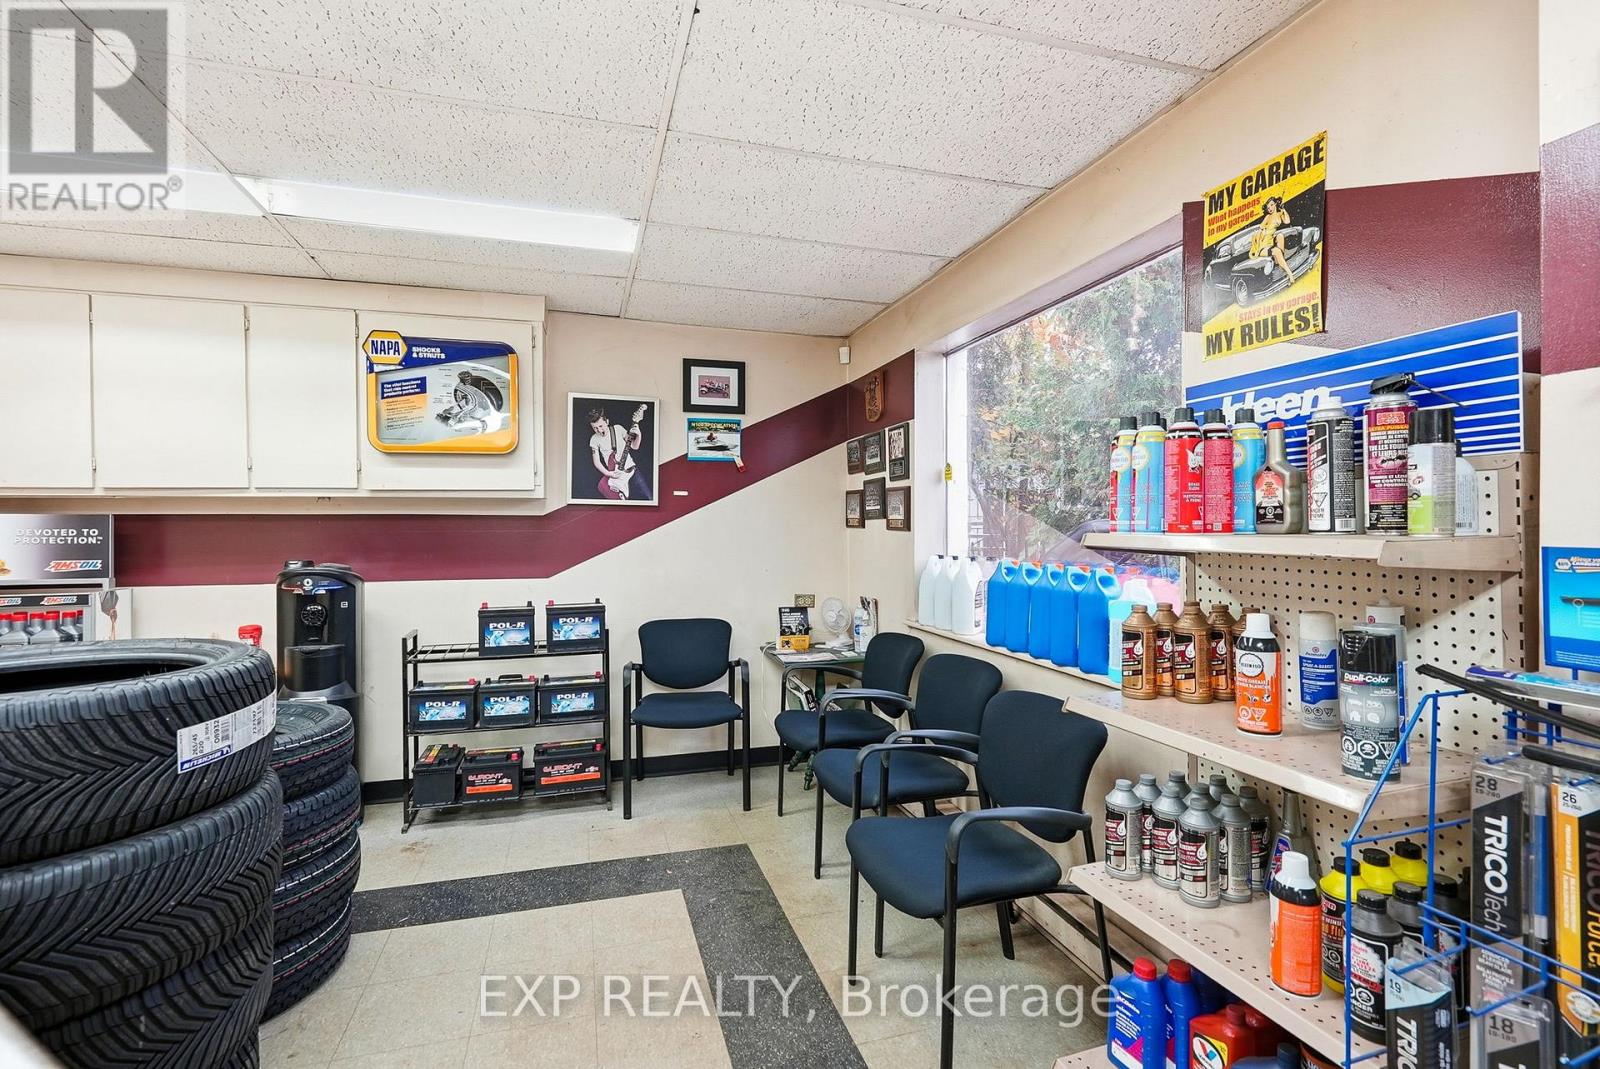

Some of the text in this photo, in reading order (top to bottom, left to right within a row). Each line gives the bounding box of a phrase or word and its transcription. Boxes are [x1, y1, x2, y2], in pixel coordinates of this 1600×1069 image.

[1208, 138, 1324, 215] MY GARAGE
[1208, 197, 1260, 226] What happens
[1208, 228, 1215, 237] in
[1216, 222, 1227, 234] my
[1239, 308, 1261, 322] STAYS
[1263, 305, 1271, 315] in
[1273, 301, 1285, 313] my
[1206, 303, 1319, 357] MY RULES!
[370, 339, 400, 356] NAPA
[82, 528, 99, 536] TO
[49, 560, 102, 571] AMSOIL
[489, 621, 525, 630] POL-R
[558, 616, 594, 624] POL-R
[1344, 672, 1392, 684] Dupli-Color
[556, 692, 589, 700] POL-R
[425, 700, 460, 708] POL-R
[1475, 775, 1498, 791] 28
[1562, 791, 1577, 804] 26
[1390, 979, 1401, 993] 19
[1489, 1015, 1514, 1034] 18
